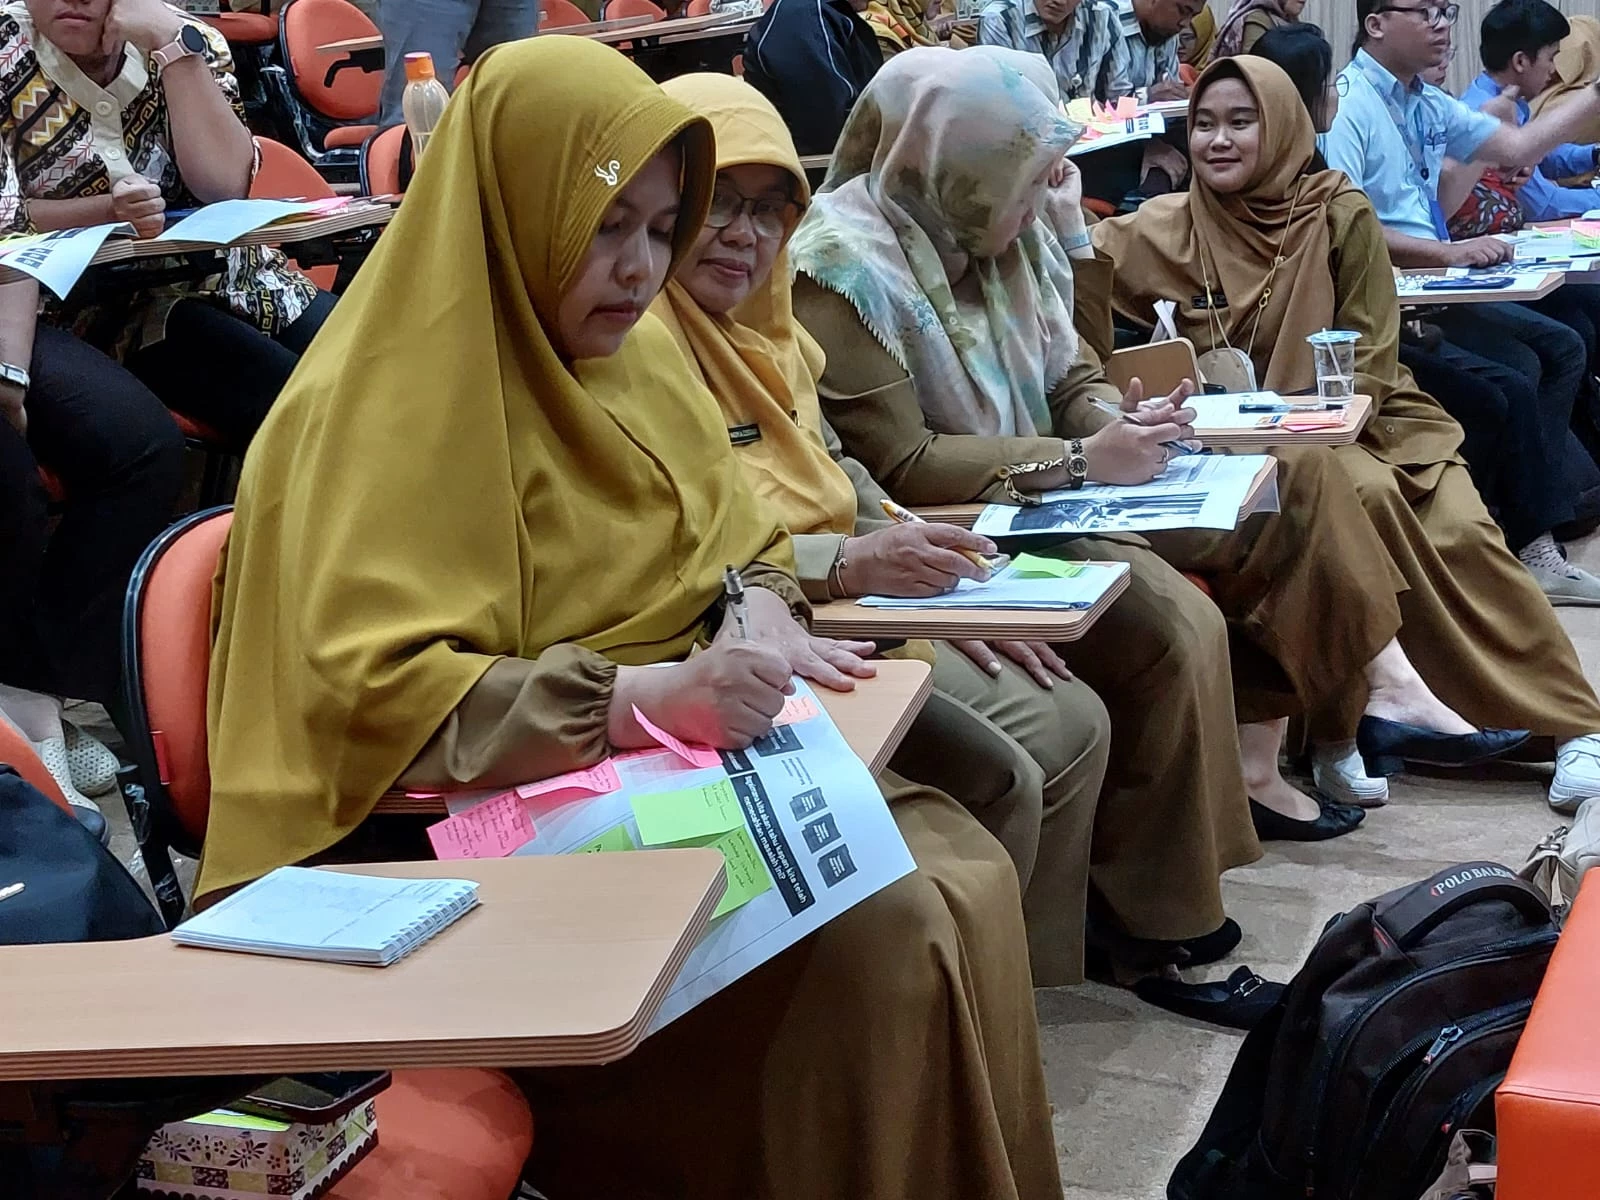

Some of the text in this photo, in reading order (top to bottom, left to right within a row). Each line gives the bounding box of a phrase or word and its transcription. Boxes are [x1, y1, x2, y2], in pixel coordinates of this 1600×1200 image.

[744, 796, 786, 880] memecahkan masalah ini?
[756, 800, 765, 814] kita
[761, 813, 772, 830] akan
[768, 828, 779, 847] tahu
[775, 846, 790, 869] kapan
[787, 868, 798, 884] kita
[794, 883, 807, 904] telah
[1435, 871, 1472, 894] POLO
